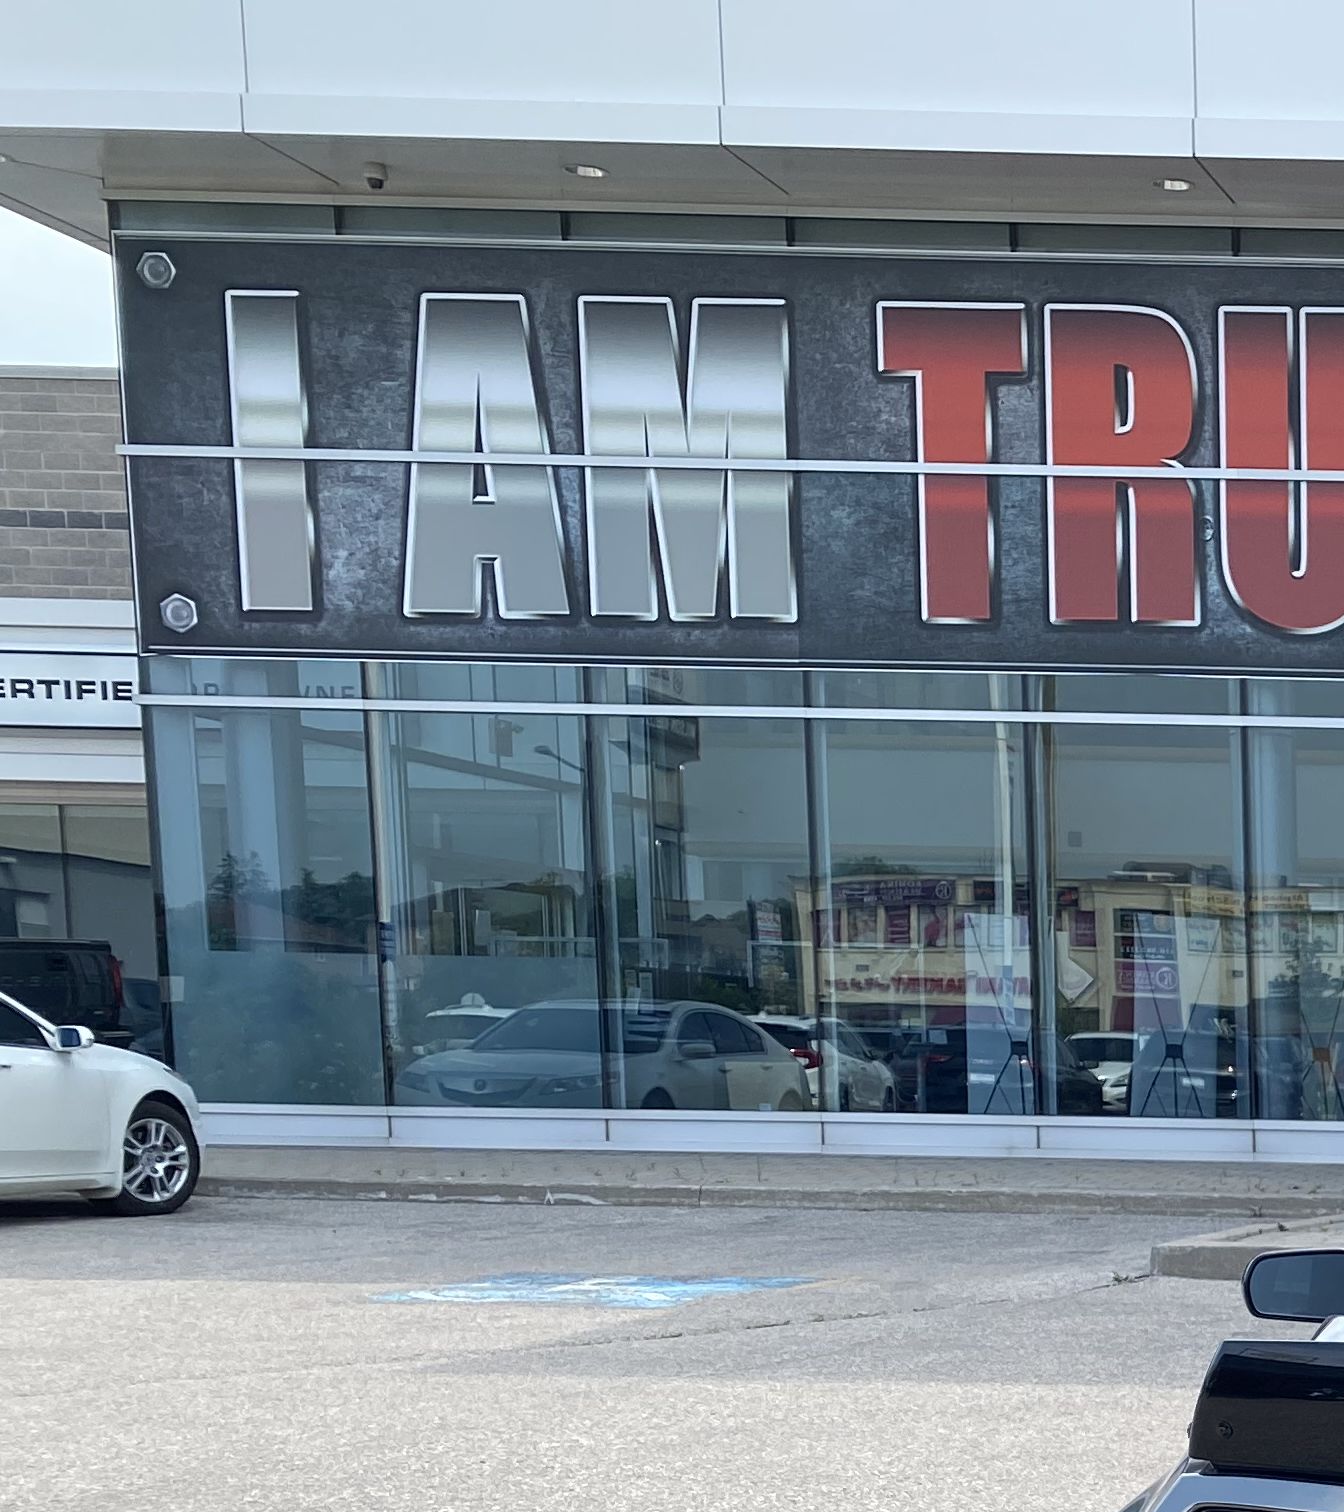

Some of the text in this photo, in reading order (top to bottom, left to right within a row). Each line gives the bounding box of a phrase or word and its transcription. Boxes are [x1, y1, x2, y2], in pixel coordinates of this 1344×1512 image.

[223, 288, 315, 613] I
[401, 291, 800, 622] AM
[0, 678, 133, 701] RTIFIE
